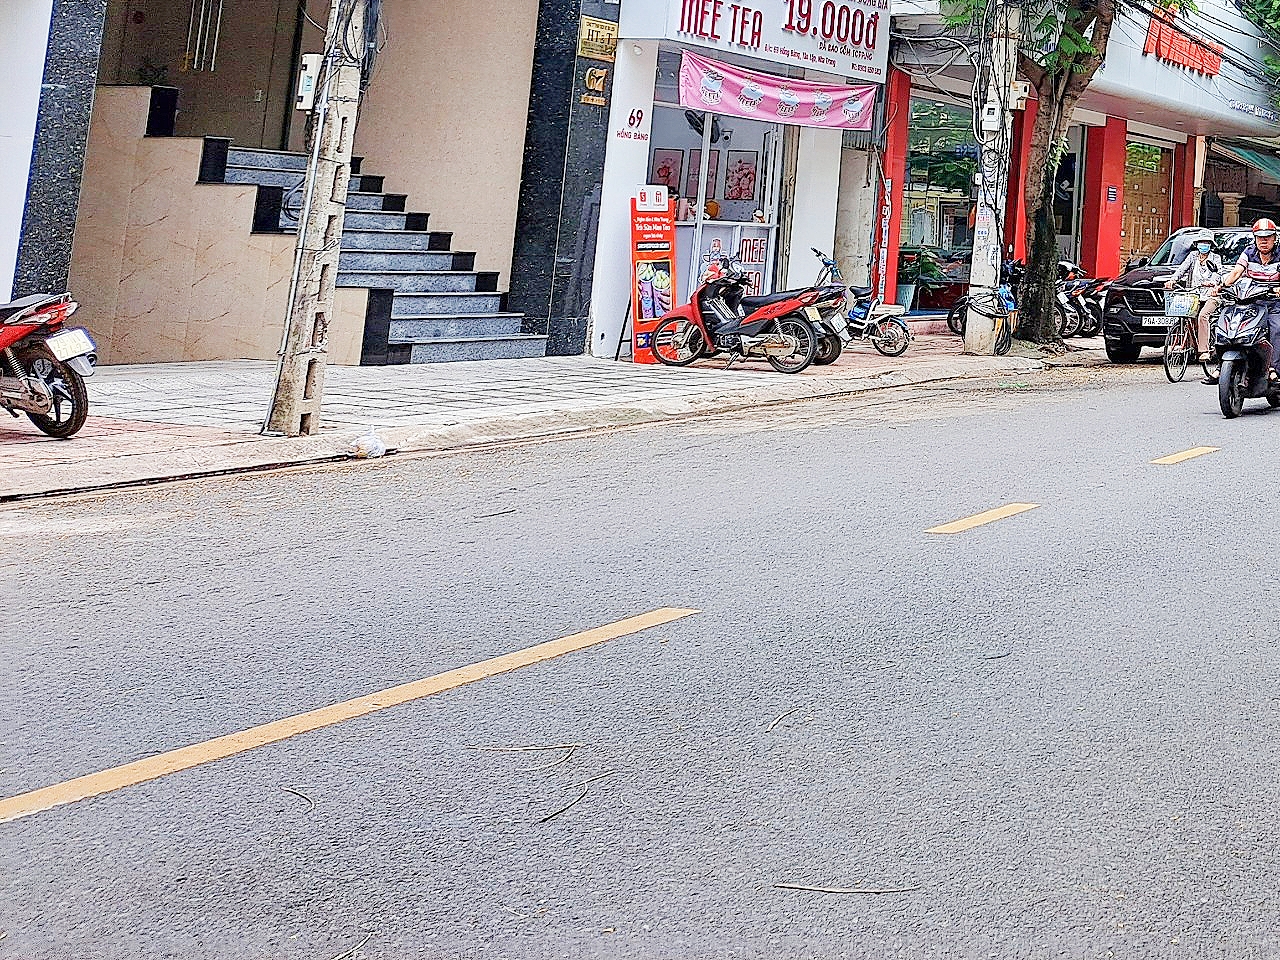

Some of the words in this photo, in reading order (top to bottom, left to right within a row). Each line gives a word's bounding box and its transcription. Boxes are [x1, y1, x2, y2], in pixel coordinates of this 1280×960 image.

[729, 3, 764, 50] TEA
[628, 107, 645, 129] 69
[741, 238, 766, 263] MEE
